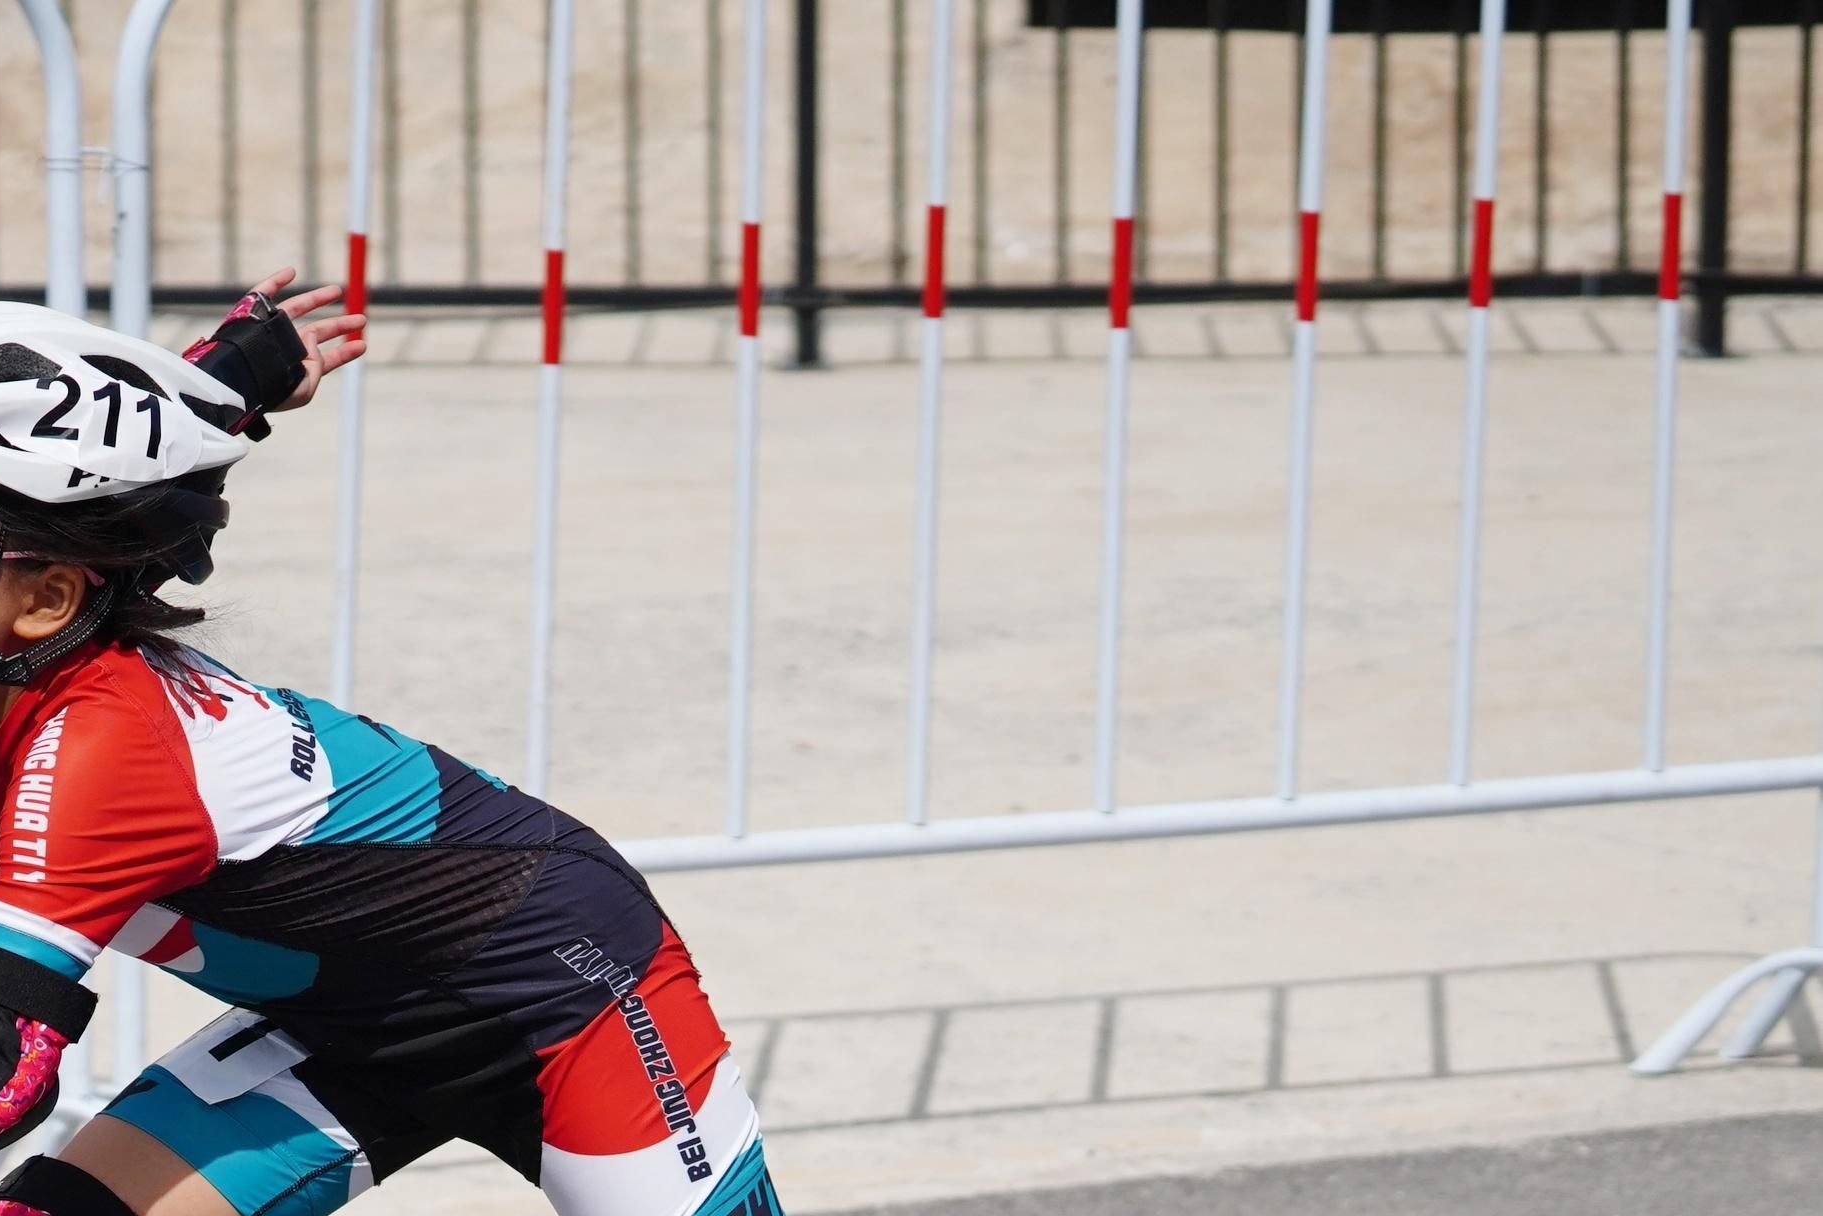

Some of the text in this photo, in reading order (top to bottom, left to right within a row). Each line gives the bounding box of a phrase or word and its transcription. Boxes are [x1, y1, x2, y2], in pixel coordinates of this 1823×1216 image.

[30, 374, 161, 460] 211
[14, 774, 54, 832] HUA
[618, 994, 677, 1081] ZHONG
[654, 1078, 696, 1133] JING
[677, 1136, 713, 1182] BEI
